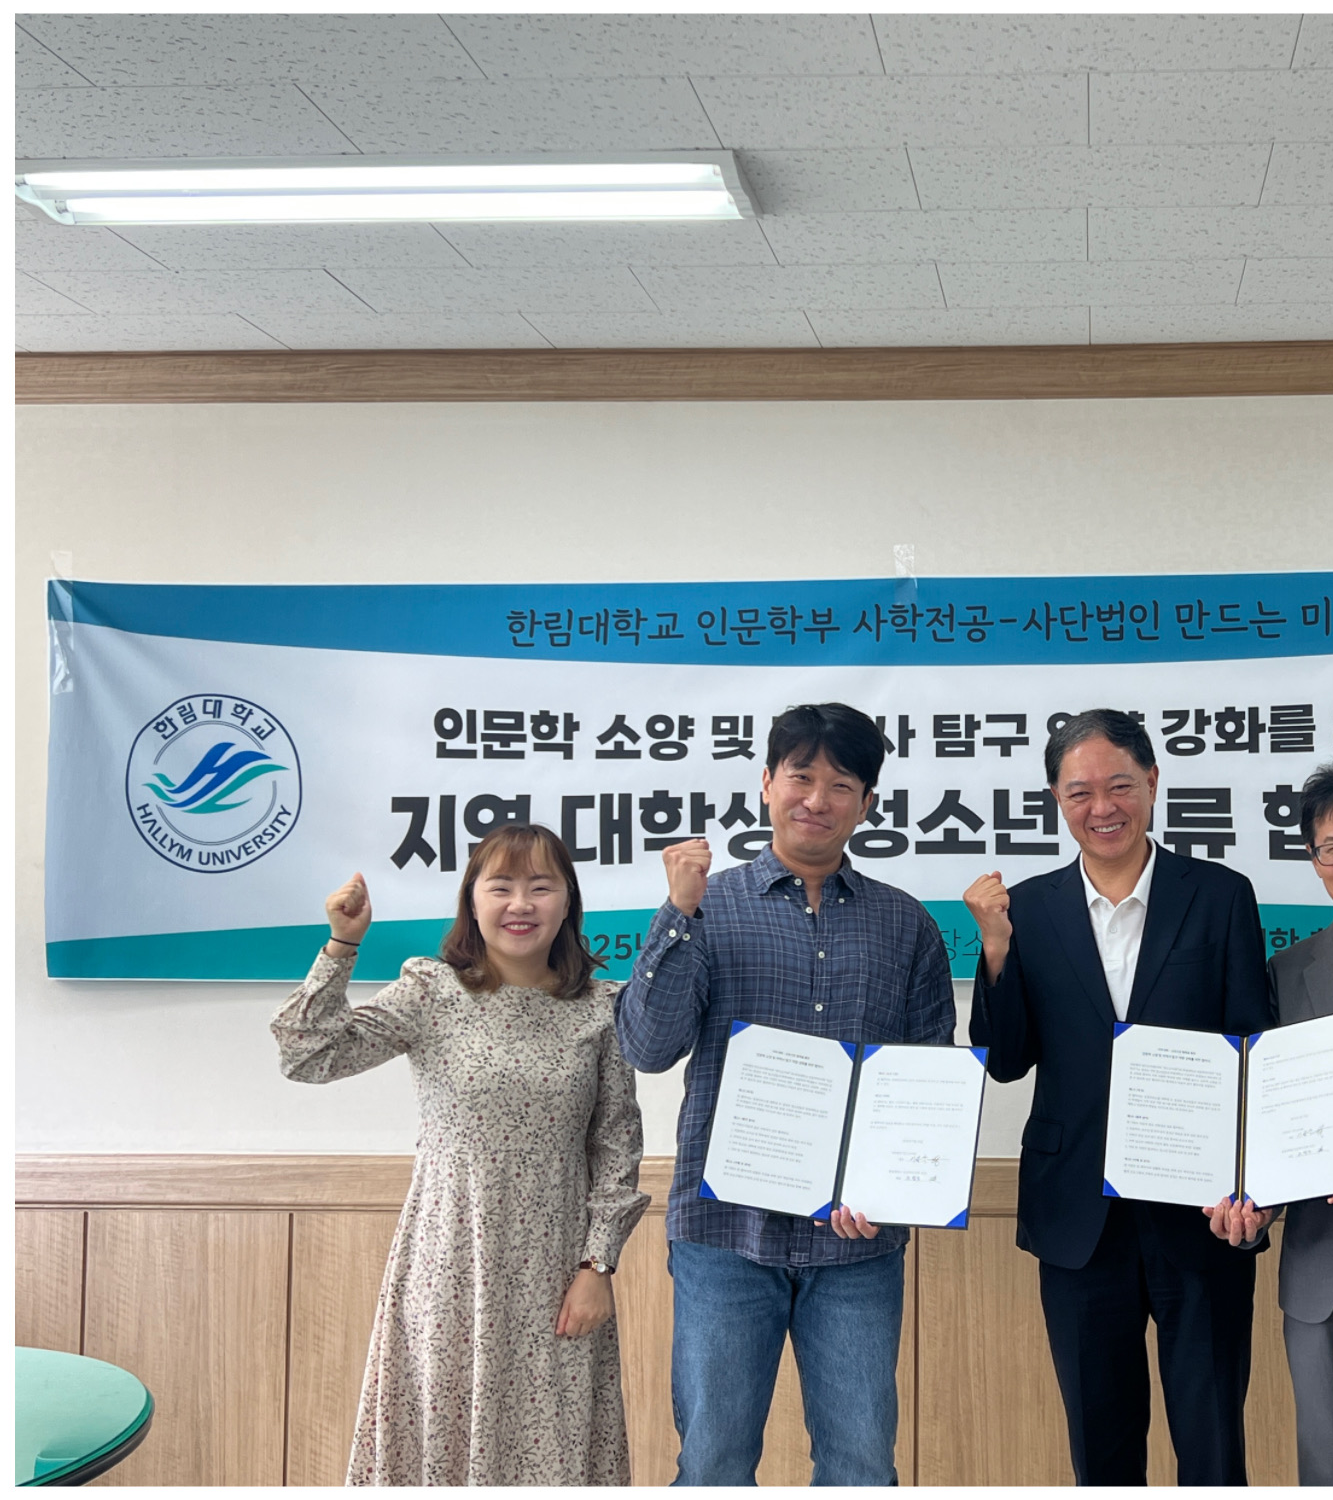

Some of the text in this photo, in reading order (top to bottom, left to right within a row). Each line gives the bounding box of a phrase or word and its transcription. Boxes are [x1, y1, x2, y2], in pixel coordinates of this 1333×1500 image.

[506, 607, 685, 647] 한림대학교
[696, 604, 841, 646] 인문학부
[852, 599, 1160, 643] 사학전공-사단법인
[1175, 599, 1287, 640] 만드는
[153, 698, 276, 741] 한림대학교
[433, 707, 580, 760] 인문학
[595, 713, 695, 761] 소양
[711, 715, 756, 761] 및
[933, 714, 1030, 758] 탐구
[1161, 703, 1316, 757] 강화를
[136, 803, 292, 867] HALLYM UNIVERSITY
